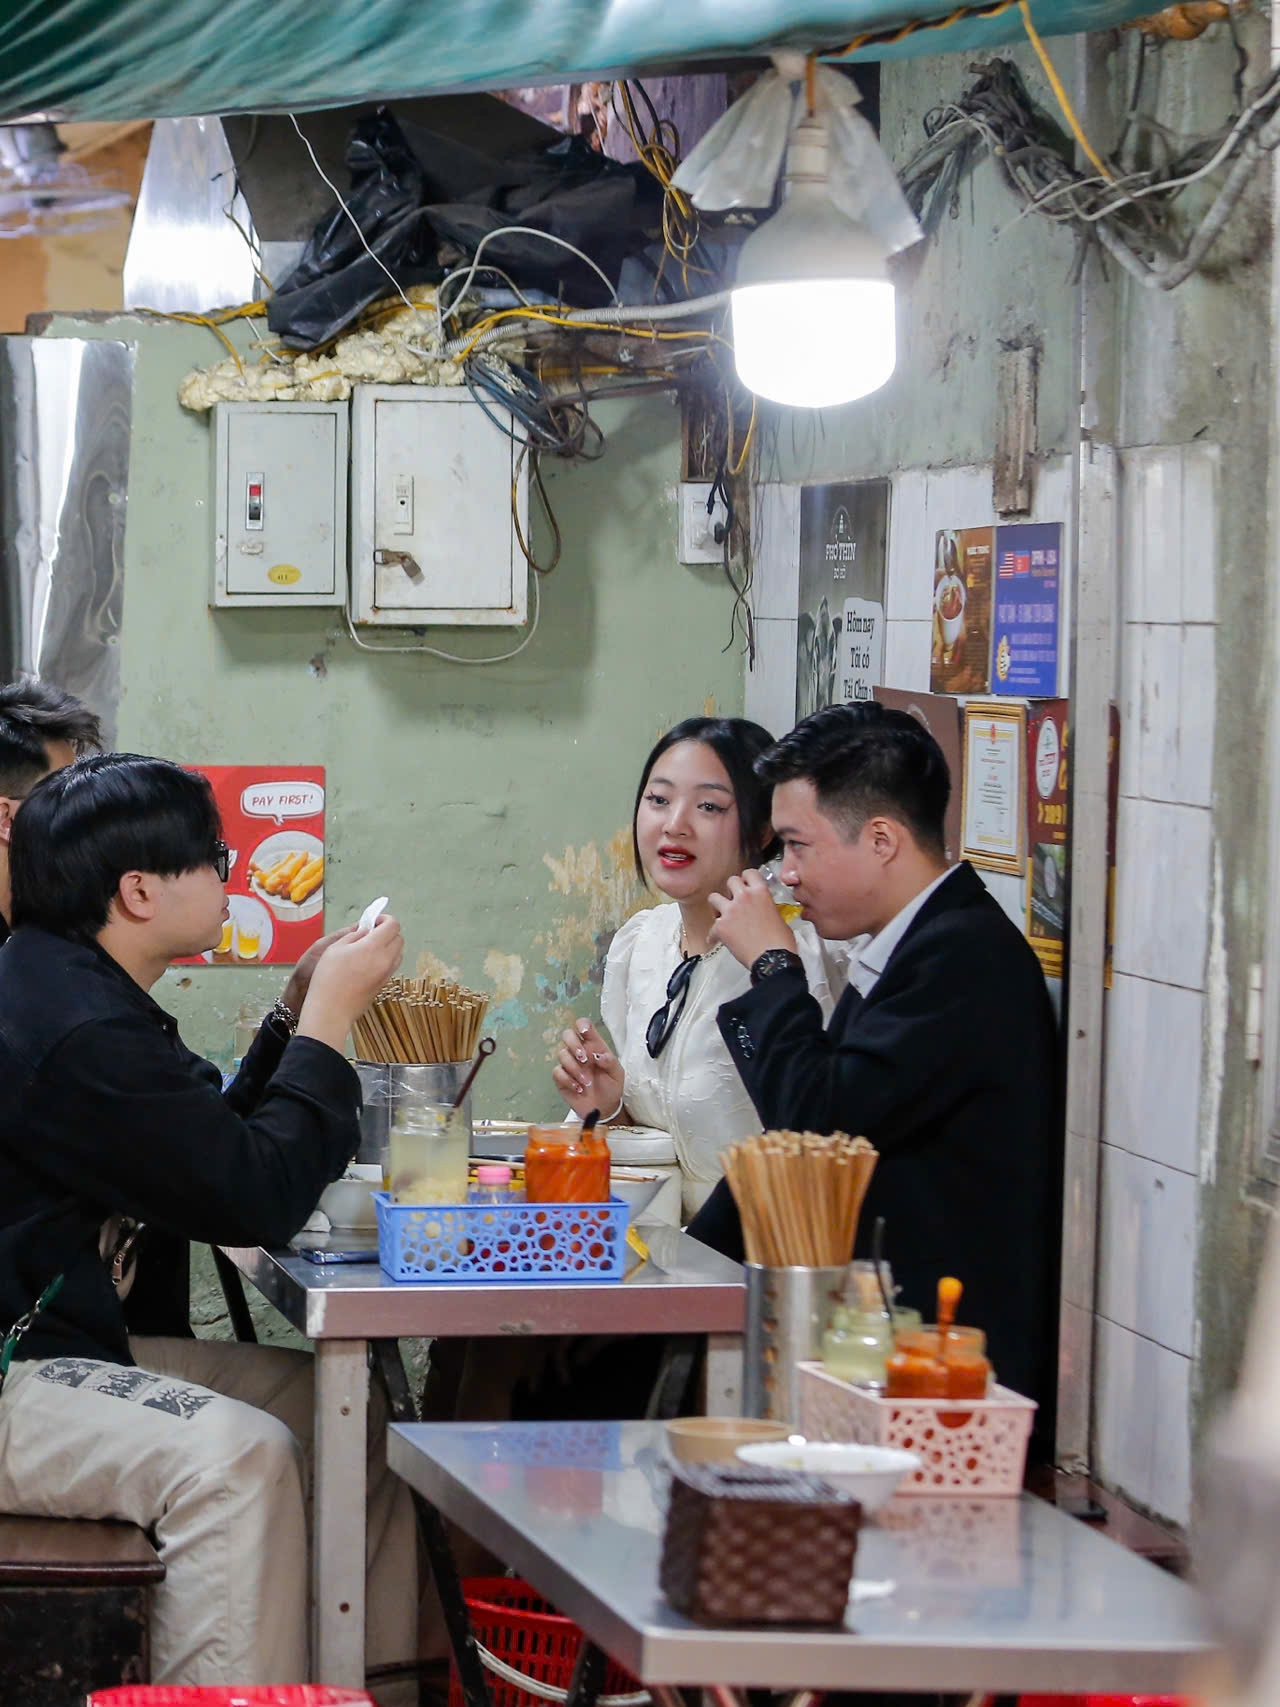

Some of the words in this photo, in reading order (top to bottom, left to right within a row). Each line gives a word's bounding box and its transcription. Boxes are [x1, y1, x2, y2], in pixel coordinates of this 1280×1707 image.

[847, 611, 862, 633] Hôm
[863, 616, 875, 640] nay
[850, 646, 861, 668] Tôi
[861, 648, 870, 669] có
[843, 678, 853, 699] Tái
[853, 677, 868, 700] Chín
[252, 796, 274, 807] PAY
[279, 794, 314, 805] FIRST!
